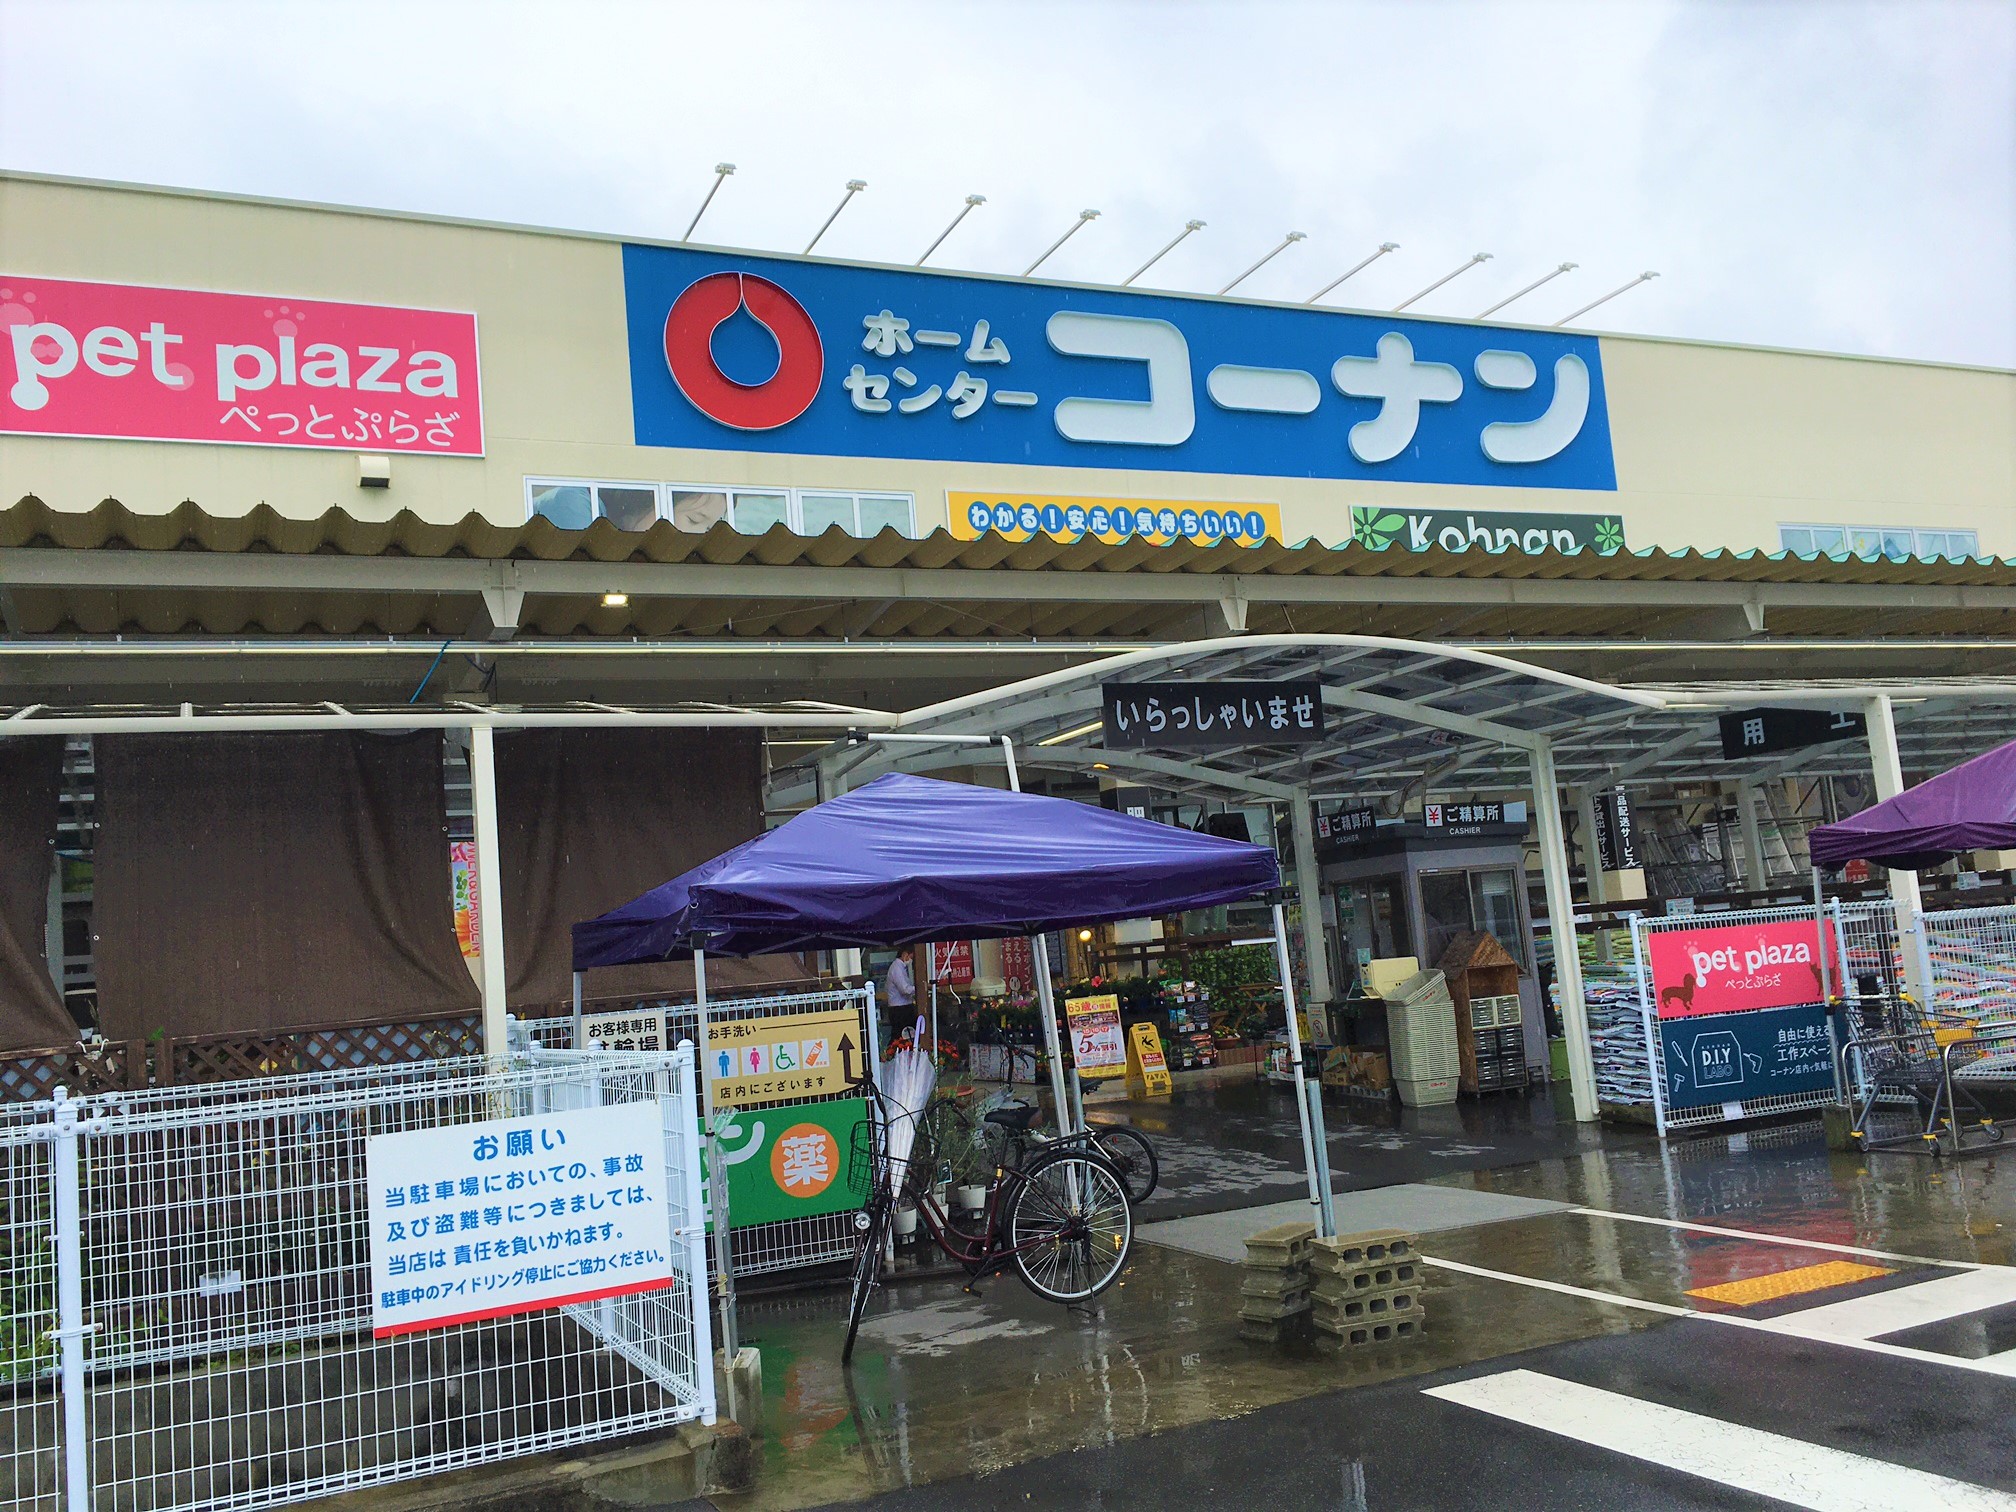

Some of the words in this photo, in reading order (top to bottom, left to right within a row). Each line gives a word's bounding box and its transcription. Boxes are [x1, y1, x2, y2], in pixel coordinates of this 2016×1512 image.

[862, 309, 1011, 365] ホーム
[10, 322, 184, 411] pet
[216, 336, 459, 402] plaza
[843, 364, 1039, 420] センター
[1046, 311, 1591, 464] コーナン
[220, 404, 461, 447] ぺっとぷらざ
[1408, 515, 1577, 552] Kohnan
[1116, 694, 1314, 732] いらっしゃいませ
[1332, 810, 1372, 832] ご精算所
[1446, 804, 1499, 823] ご精算所
[1449, 826, 1483, 836] CASHIER
[1335, 834, 1360, 845] CASHIER
[1692, 945, 1740, 988] pet
[1745, 942, 1811, 975] plaza
[1725, 973, 1782, 990] ぺっとぷらざ
[588, 1017, 657, 1038] お客様専用
[708, 1024, 757, 1040] お手洗い
[1701, 1047, 1731, 1066] D.I.Y
[1703, 1063, 1734, 1079] LABO
[720, 1076, 826, 1099] 店内にございます
[472, 1128, 567, 1161] お願い
[782, 1134, 829, 1187] 薬
[385, 1153, 644, 1208] 当駐車場においての、事故
[386, 1185, 653, 1242] 及び盗難等につきましては、
[380, 1248, 665, 1309] 駐車中のアイドリング停止にご協力ください。
